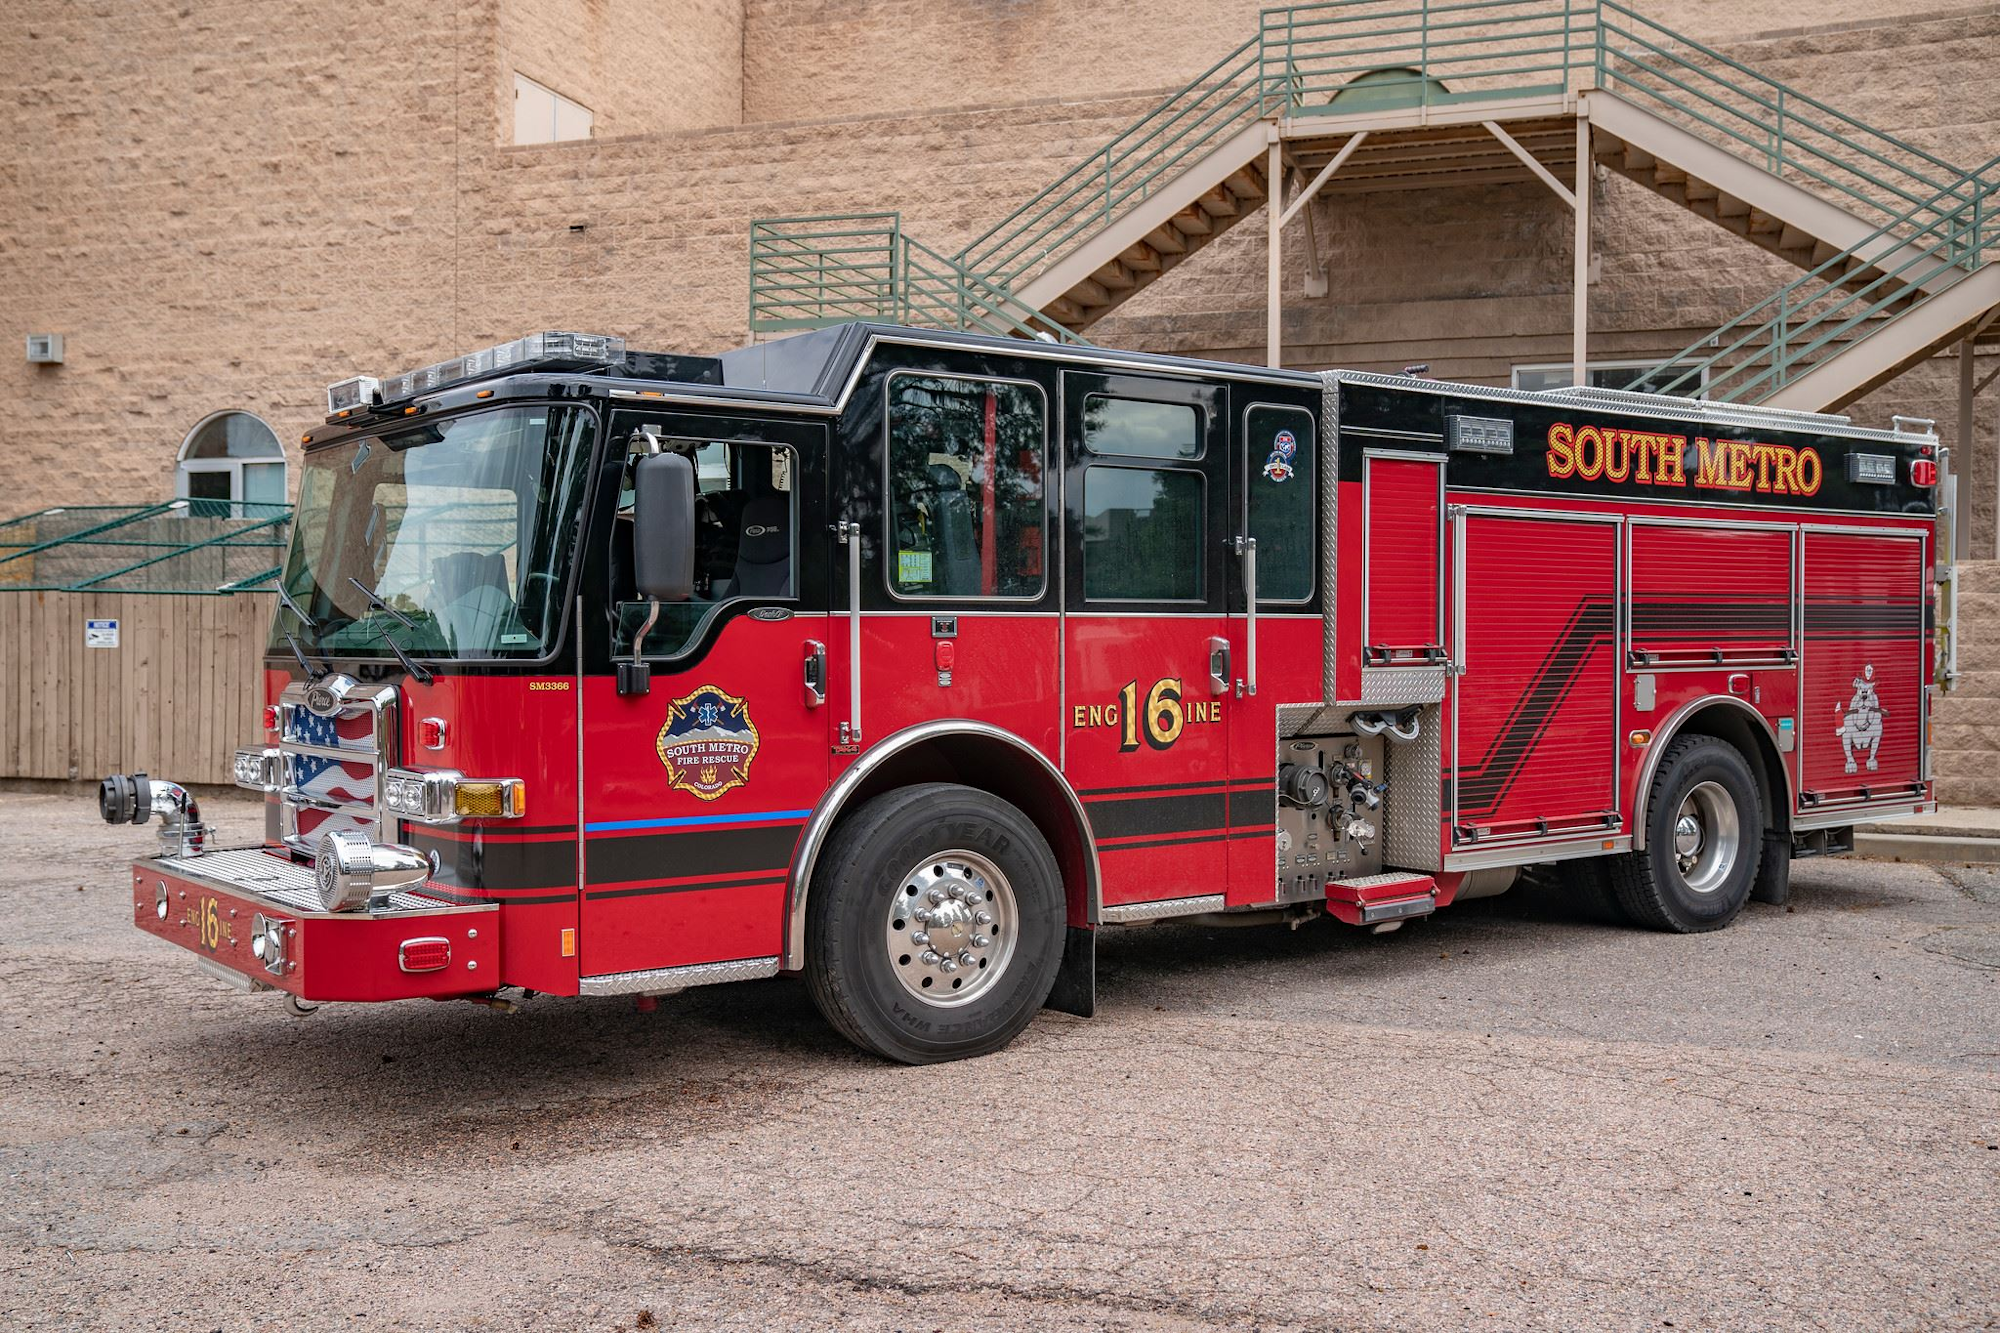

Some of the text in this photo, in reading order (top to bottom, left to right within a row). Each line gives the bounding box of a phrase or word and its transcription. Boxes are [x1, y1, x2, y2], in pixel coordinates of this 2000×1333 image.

[1546, 422, 1823, 497] SOUTH METRO
[529, 681, 570, 691] SM3366
[1118, 678, 1185, 753] 16
[666, 742, 749, 759] SOUTH METRO
[677, 754, 739, 766] FIRE RESCUE
[693, 781, 723, 791] COLORADO
[199, 896, 219, 952] 16
